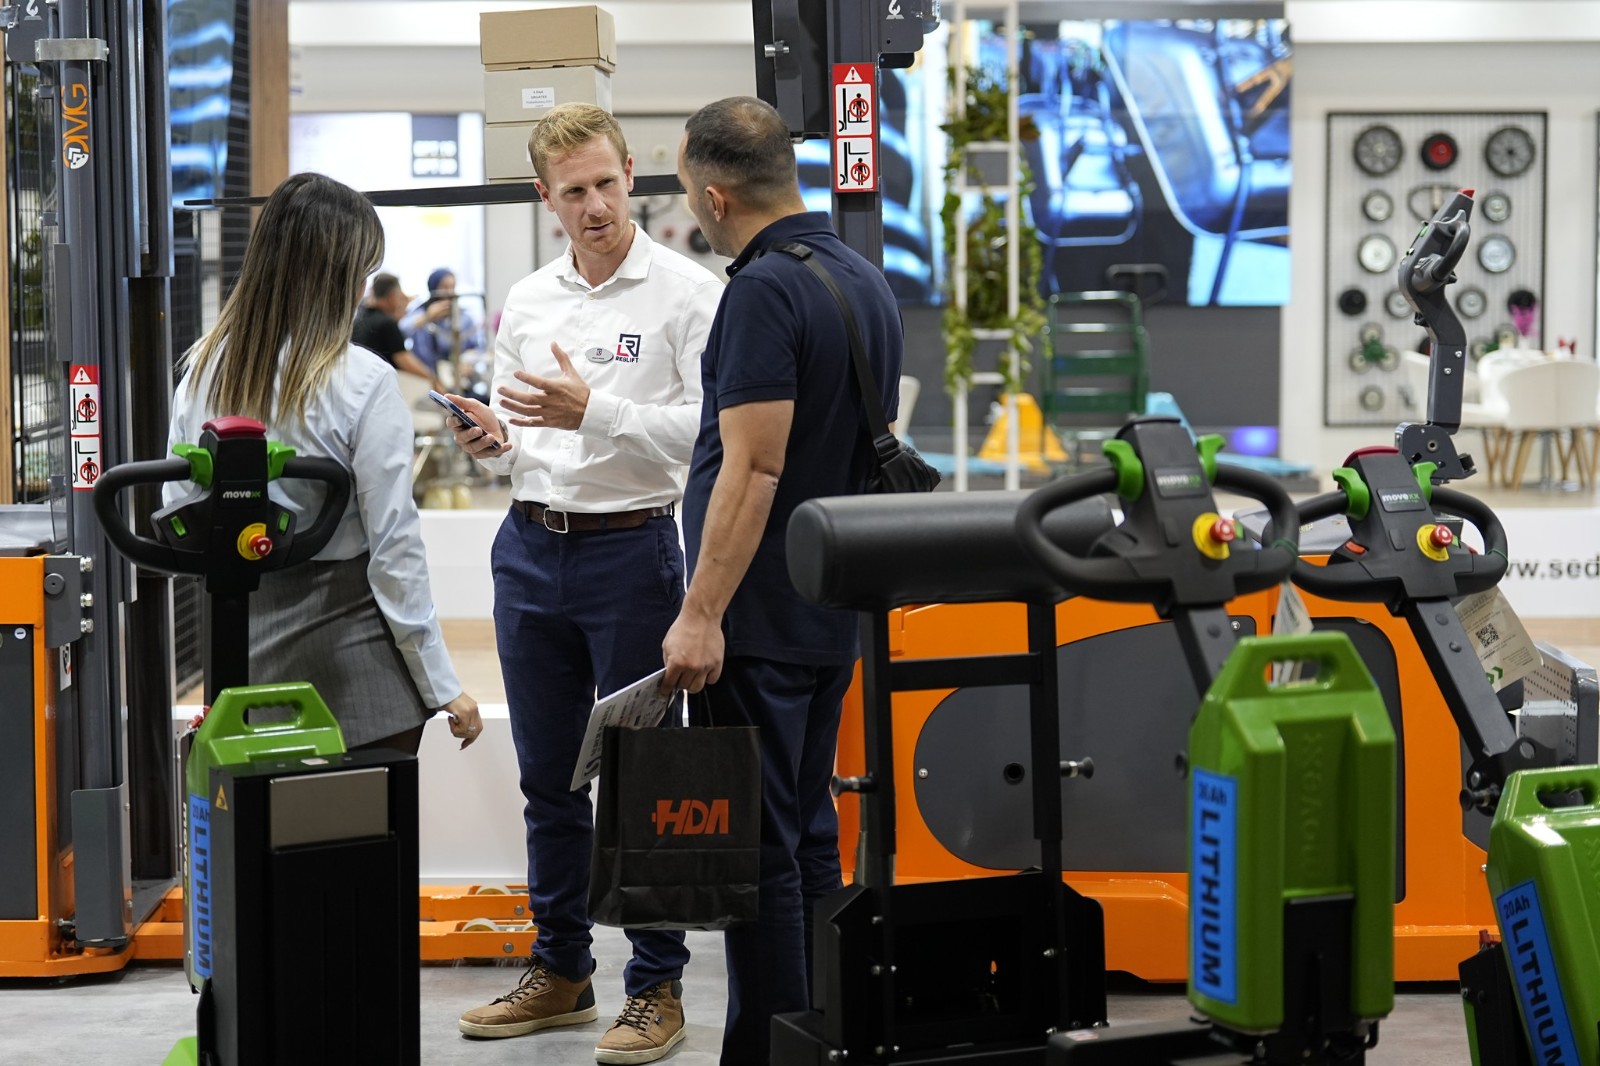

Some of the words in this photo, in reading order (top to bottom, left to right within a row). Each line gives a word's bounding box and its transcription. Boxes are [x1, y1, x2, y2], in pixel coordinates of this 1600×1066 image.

[194, 824, 211, 970] LITHIUM
[1200, 807, 1222, 987] LITHIUM
[1503, 895, 1531, 920] 20Ah
